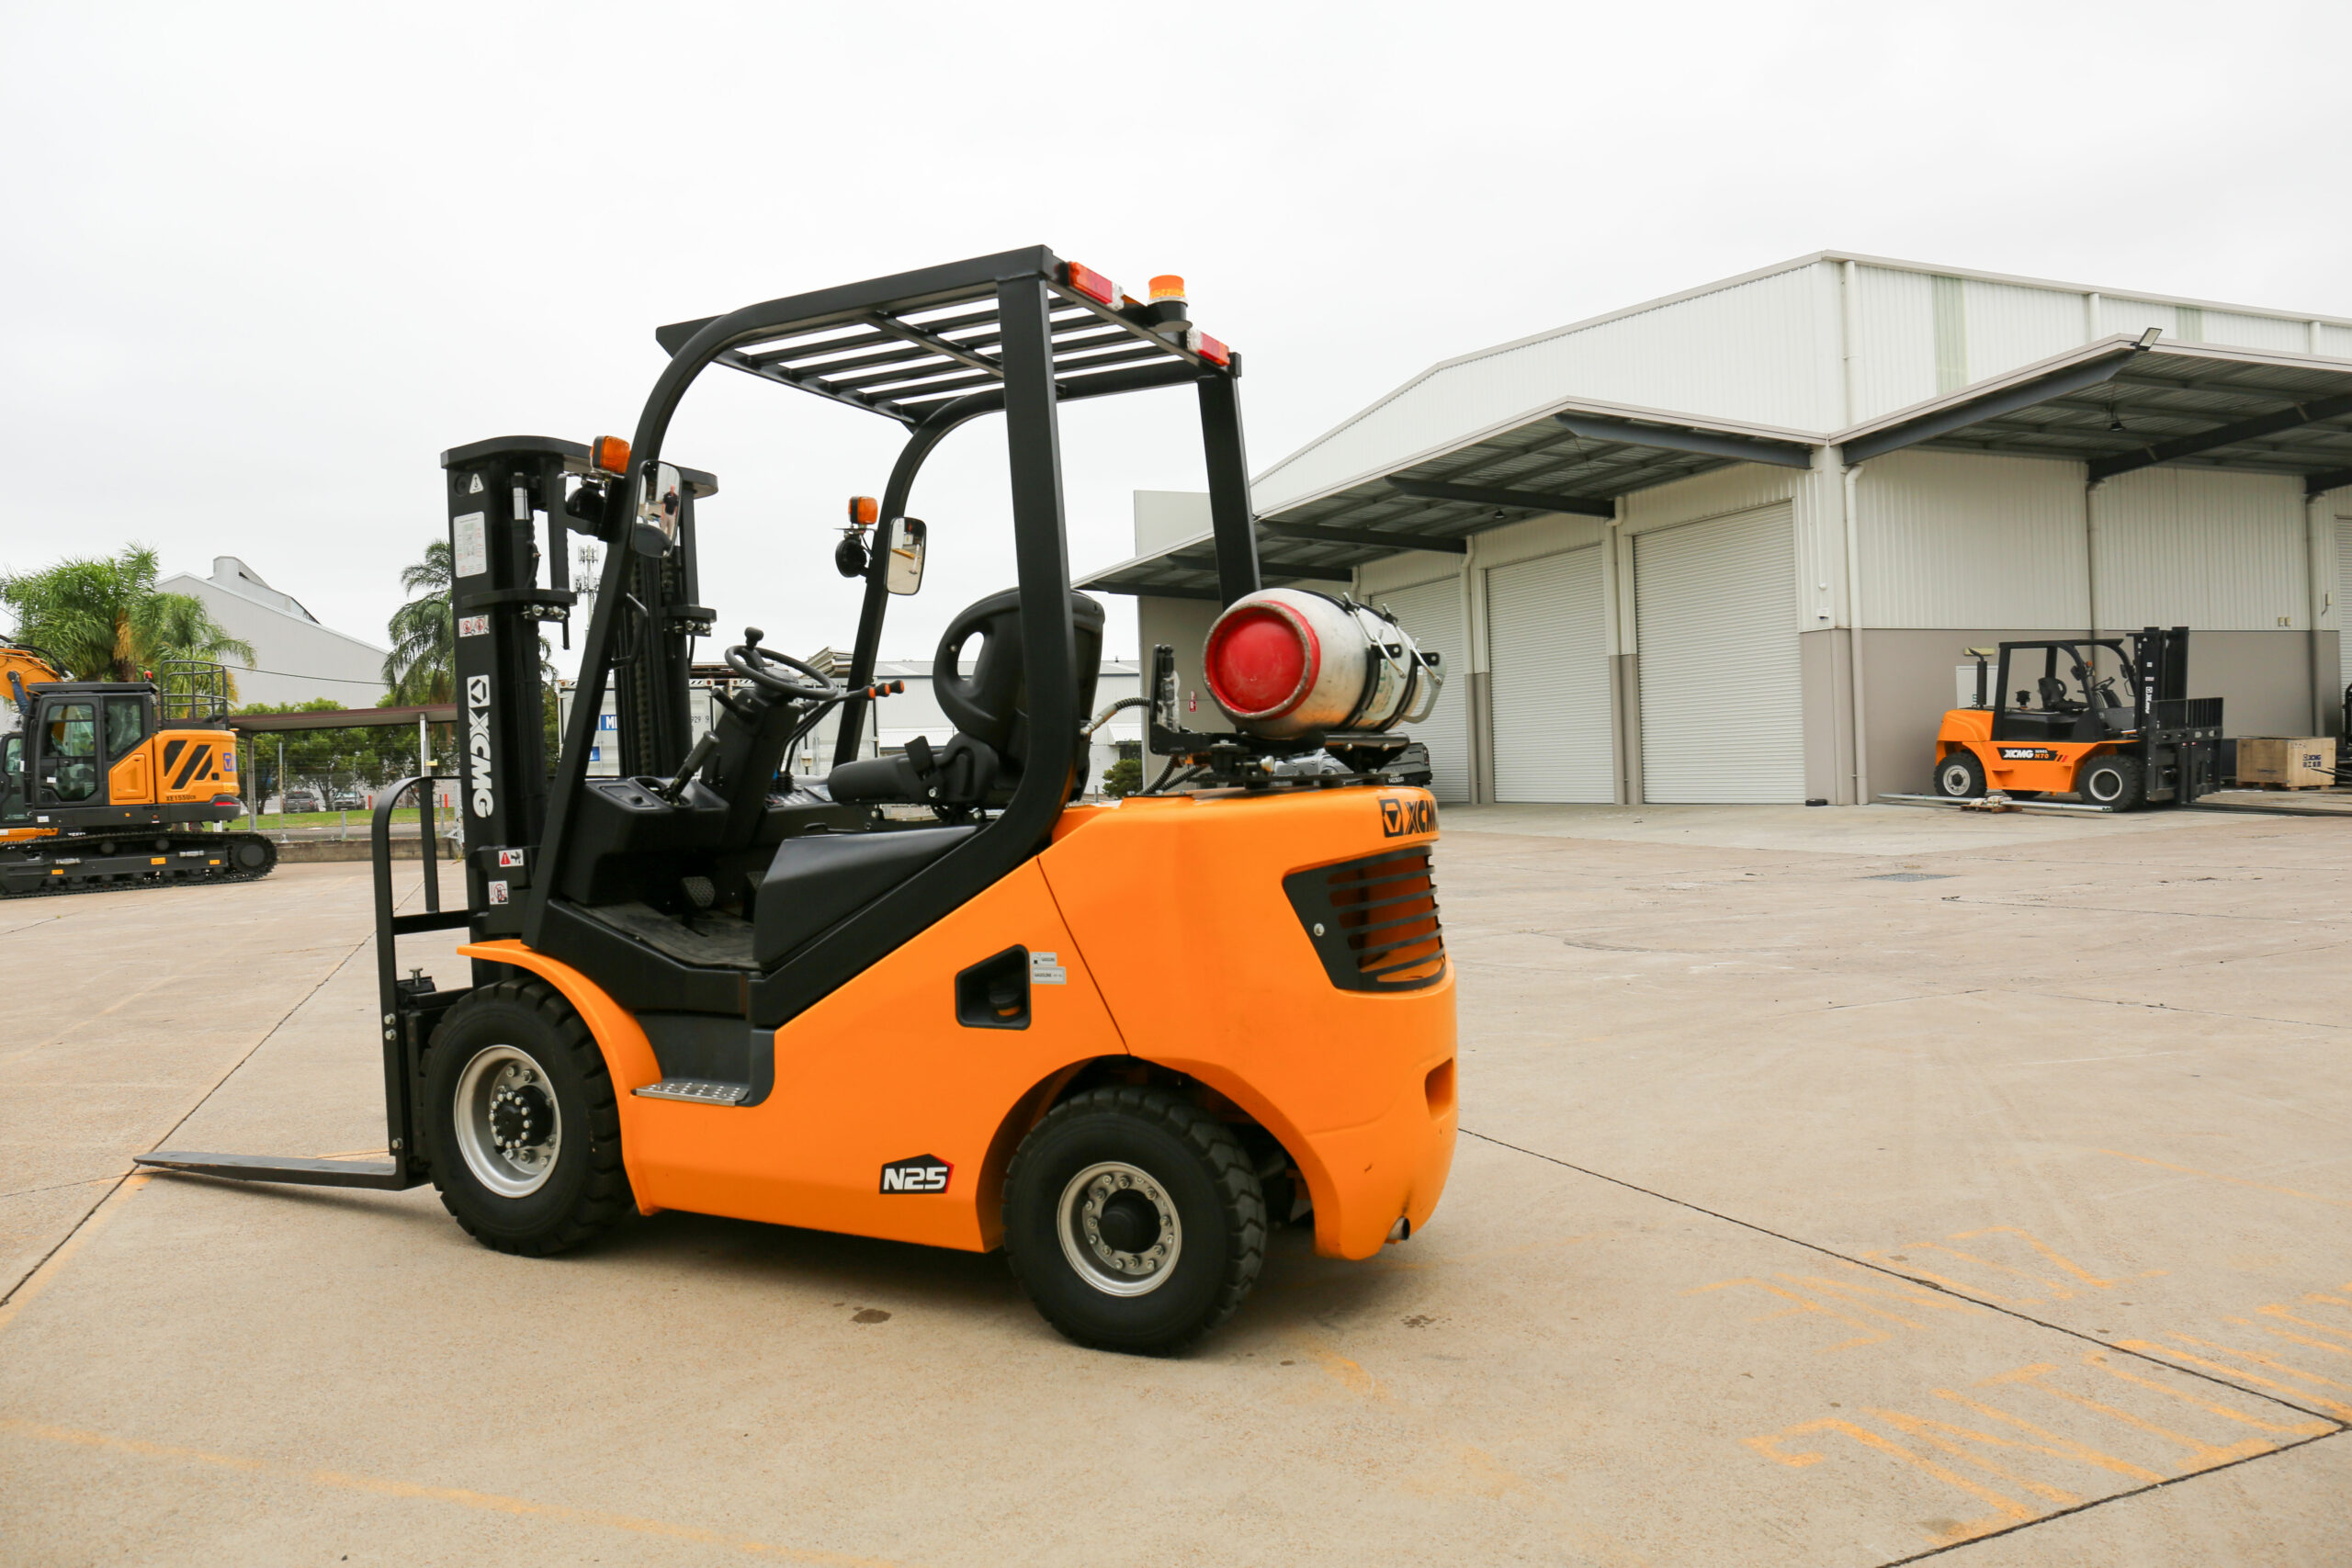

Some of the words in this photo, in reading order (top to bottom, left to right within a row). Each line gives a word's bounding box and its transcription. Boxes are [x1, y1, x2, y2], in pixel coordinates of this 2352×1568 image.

[468, 711, 494, 818] XCMG
[2003, 749, 2034, 759] XCMG
[883, 1166, 948, 1190] N25
